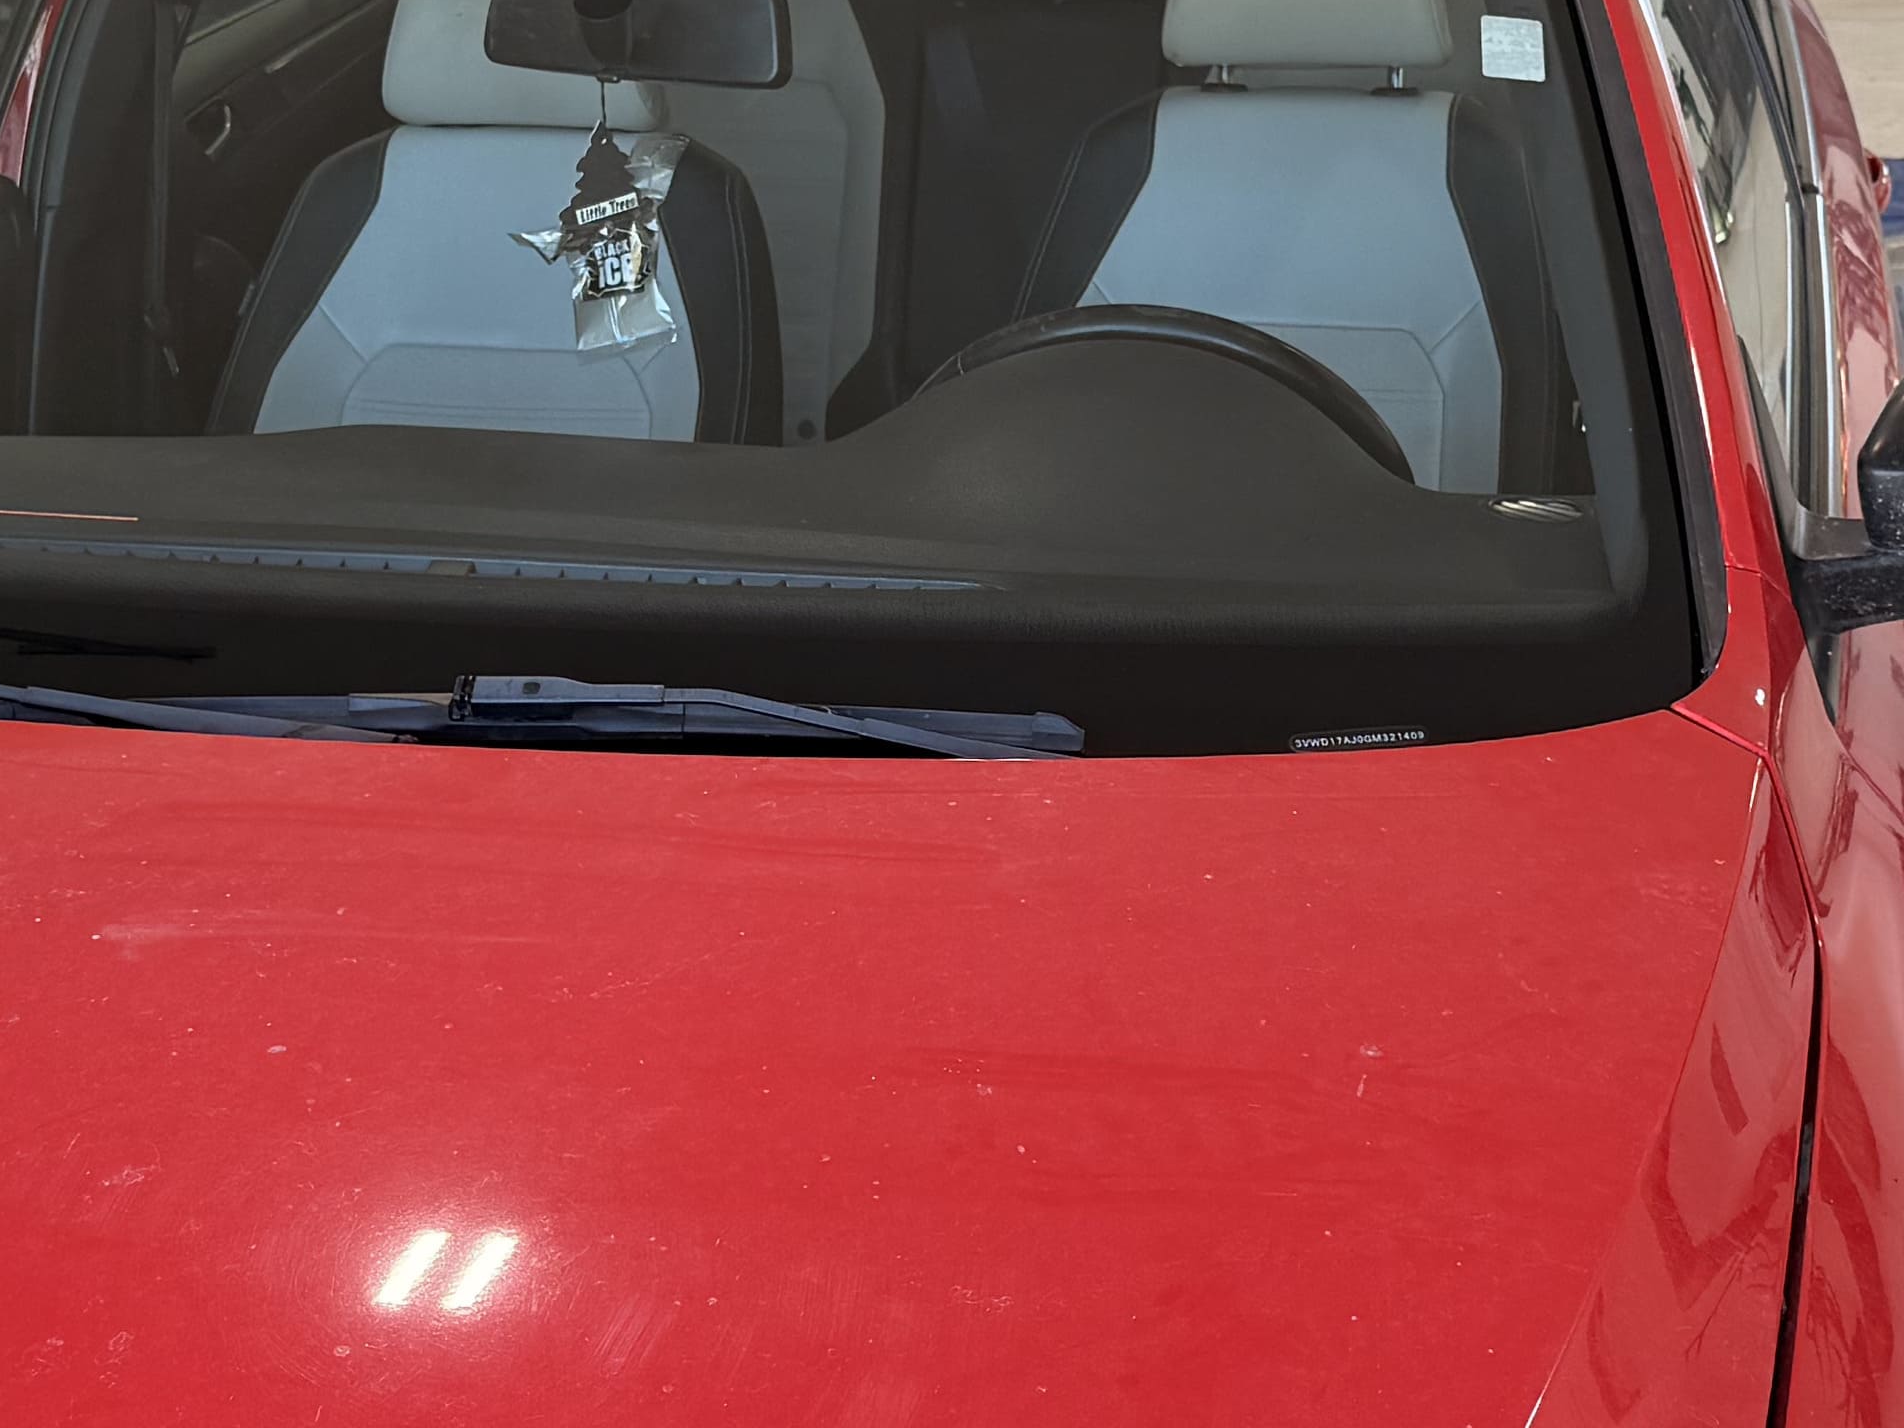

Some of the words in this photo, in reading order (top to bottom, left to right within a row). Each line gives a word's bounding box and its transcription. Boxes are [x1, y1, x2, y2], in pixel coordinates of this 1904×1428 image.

[580, 205, 607, 223] Little
[608, 197, 637, 215] Trees
[594, 239, 631, 260] BLACK
